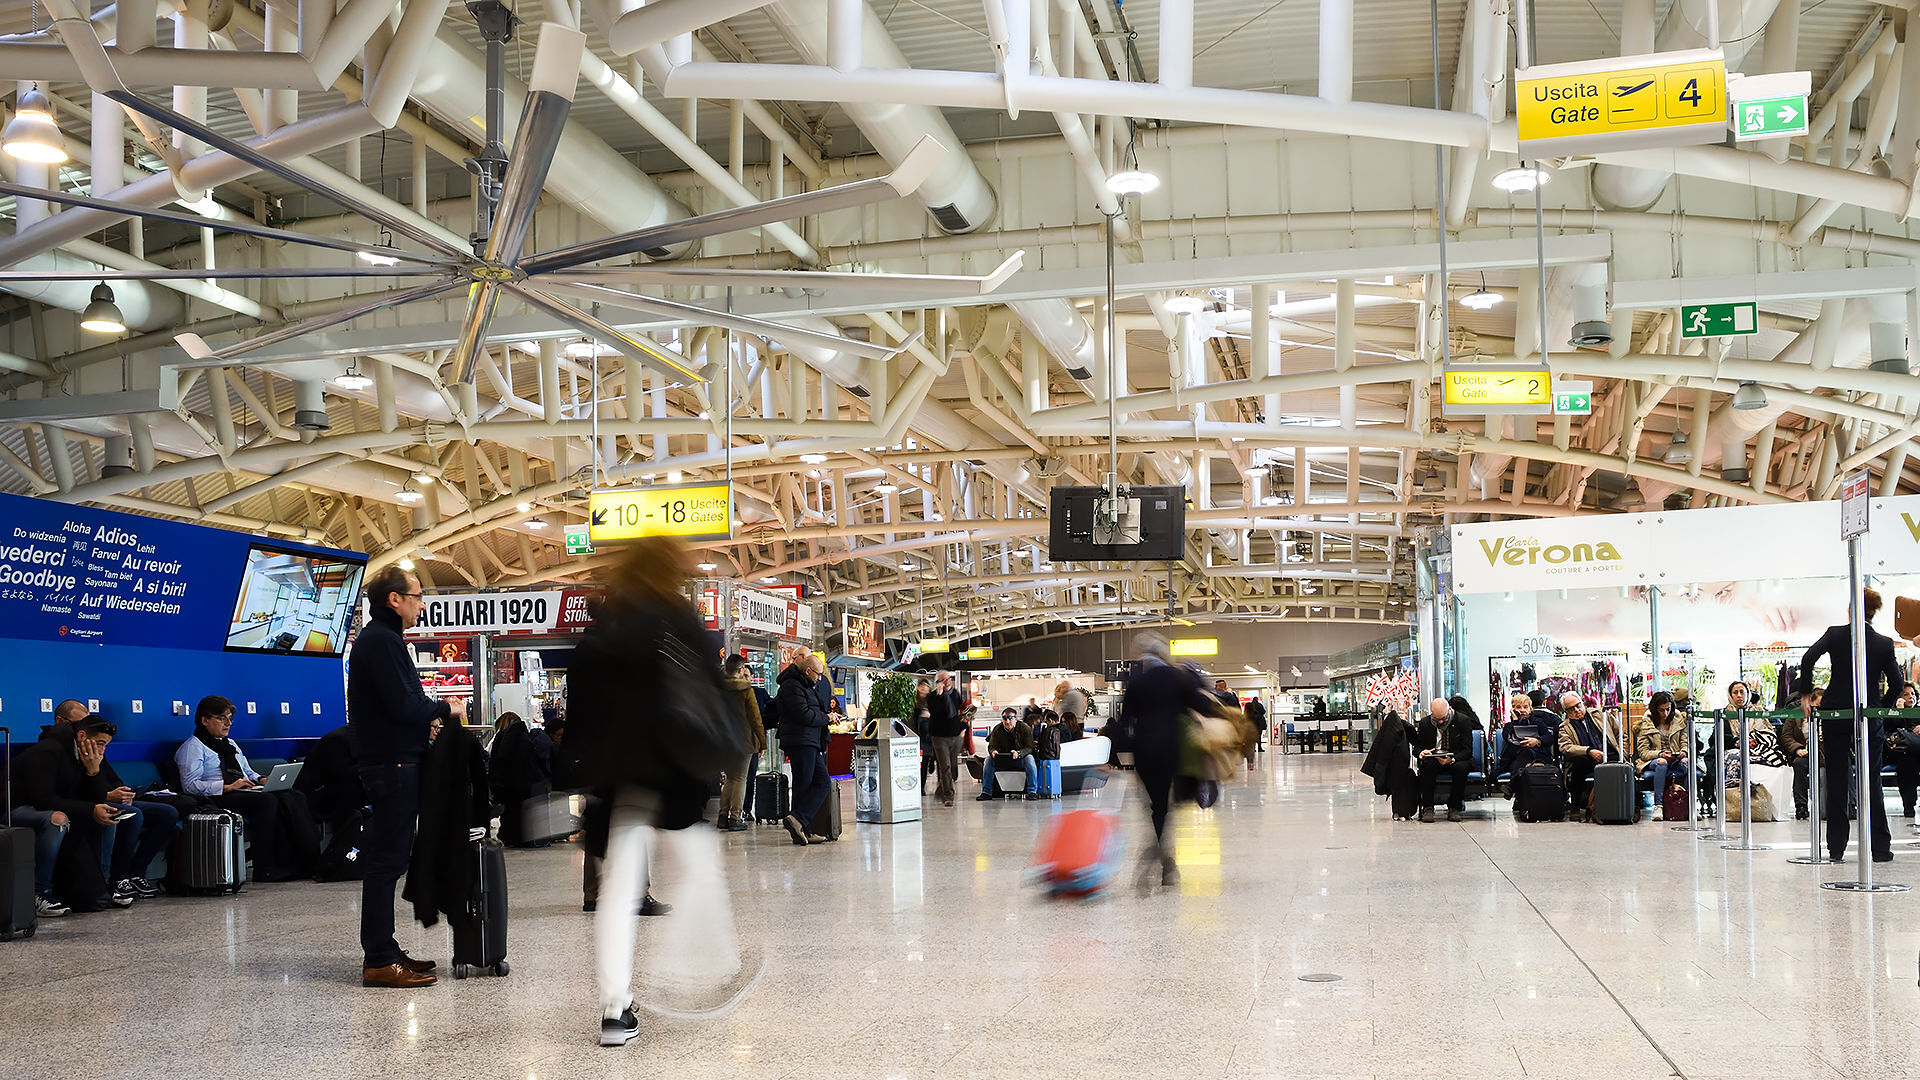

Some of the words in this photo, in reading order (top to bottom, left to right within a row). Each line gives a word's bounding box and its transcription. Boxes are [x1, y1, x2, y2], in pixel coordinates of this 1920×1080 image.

[1534, 83, 1599, 102] Uscita
[1678, 78, 1702, 108] 4
[1551, 105, 1600, 125] Gate
[1453, 375, 1488, 385] Uscita
[1528, 379, 1540, 396] 2
[1462, 387, 1488, 399] Gate
[690, 497, 727, 511] Uscite
[614, 503, 639, 527] 10
[660, 500, 687, 525] 18
[690, 510, 724, 524] Gates
[13, 528, 27, 538] Do
[29, 530, 67, 543] widzenia
[62, 520, 91, 535] Aloha
[93, 525, 138, 547] Adios
[1504, 535, 1539, 549] Carla
[91, 547, 121, 561] Farvel
[136, 543, 156, 554] Lehit
[1478, 537, 1623, 568] Verona
[122, 554, 141, 570] Au
[144, 560, 182, 575] revoir
[1545, 567, 1582, 575] COUTURE
[0, 564, 76, 592] Goodbye
[84, 577, 118, 589] Sayonara
[104, 569, 119, 579] Tam
[119, 572, 133, 581] biet
[132, 578, 144, 593] A
[147, 580, 160, 595] si
[161, 582, 188, 598] biri!
[41, 603, 72, 614] Namaste
[79, 593, 104, 608] Auf
[106, 594, 181, 615] Wiedersehen
[414, 600, 495, 627] AGLIARI
[500, 598, 547, 624] 1920
[1518, 636, 1551, 655] -50%
